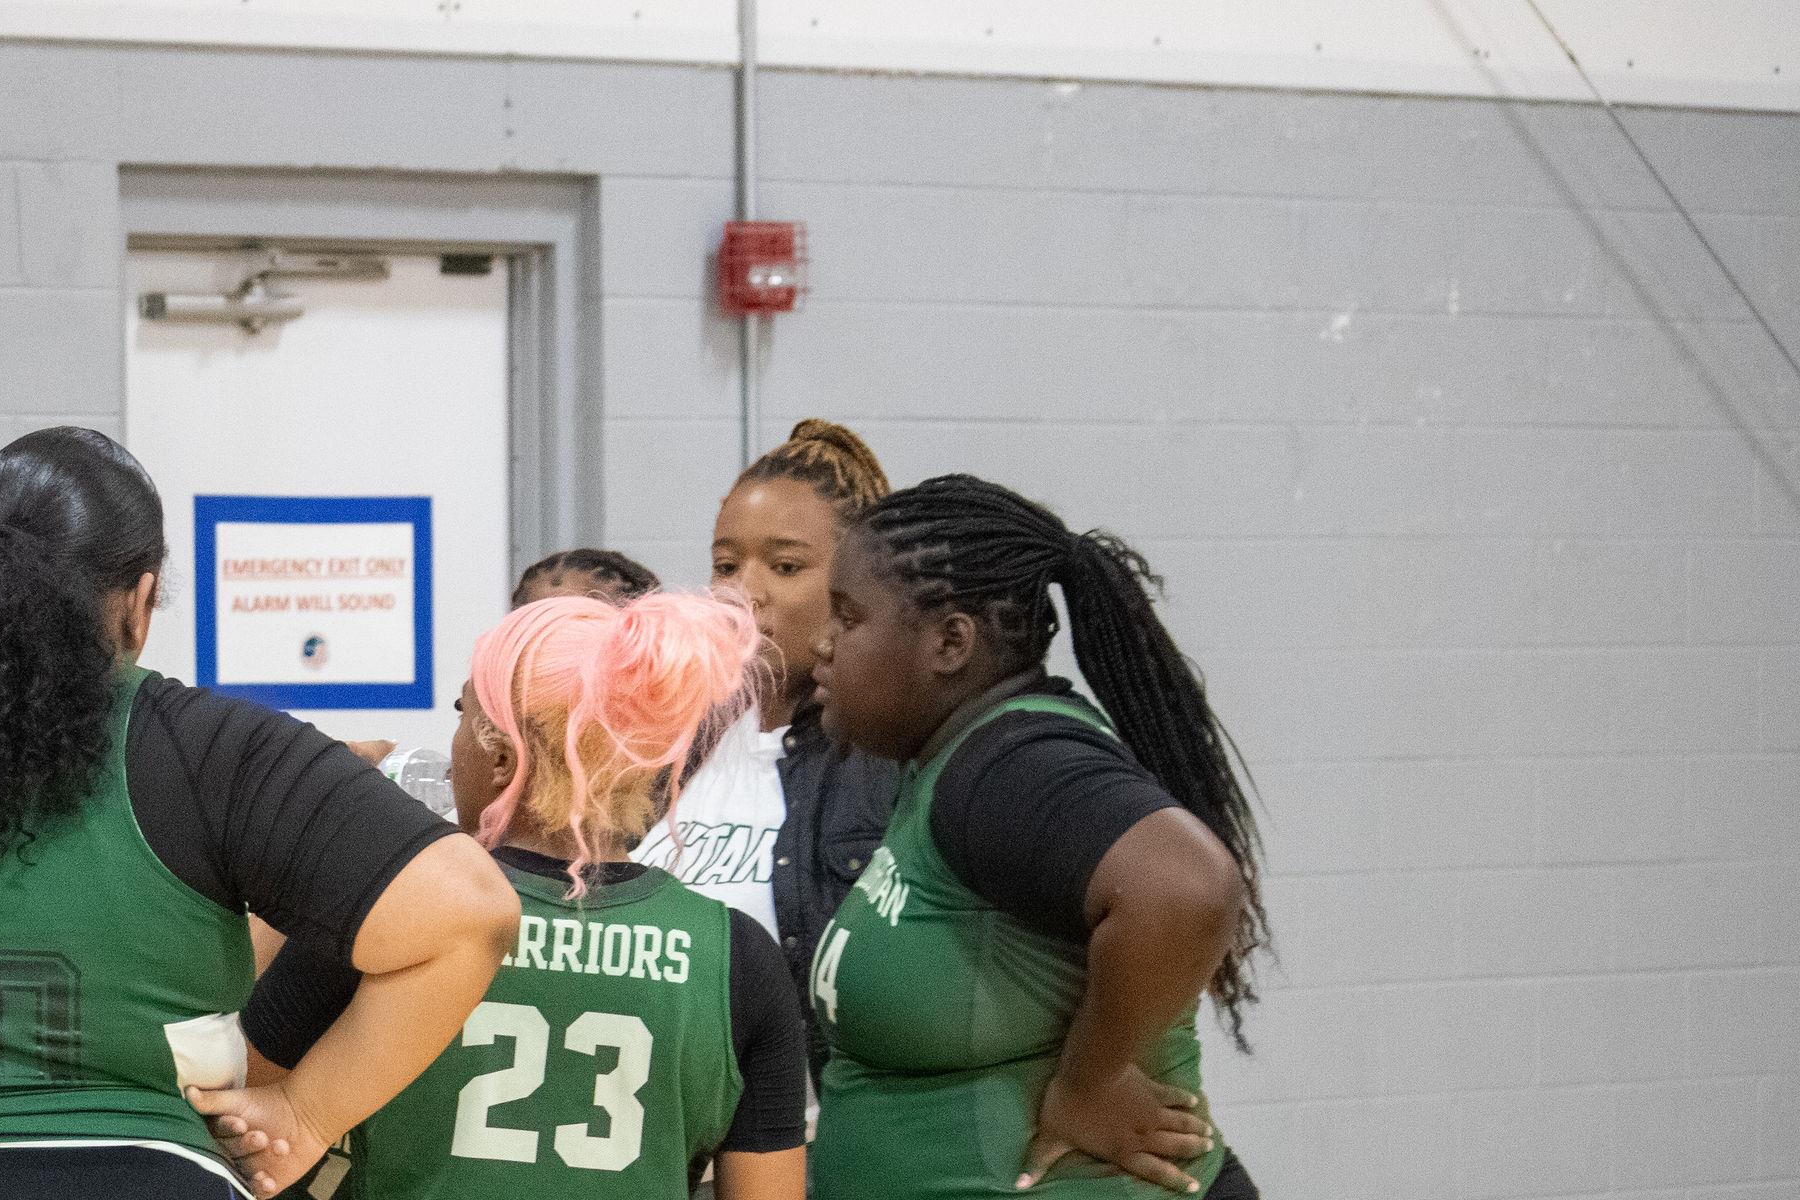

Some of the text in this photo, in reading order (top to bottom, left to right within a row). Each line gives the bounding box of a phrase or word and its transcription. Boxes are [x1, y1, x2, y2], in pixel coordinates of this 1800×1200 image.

[222, 556, 406, 576] EMERGENCY EXIT ONLY
[231, 593, 396, 613] ALARM WILL SOUND
[500, 914, 692, 984] RRIORS
[451, 1001, 654, 1172] 23
